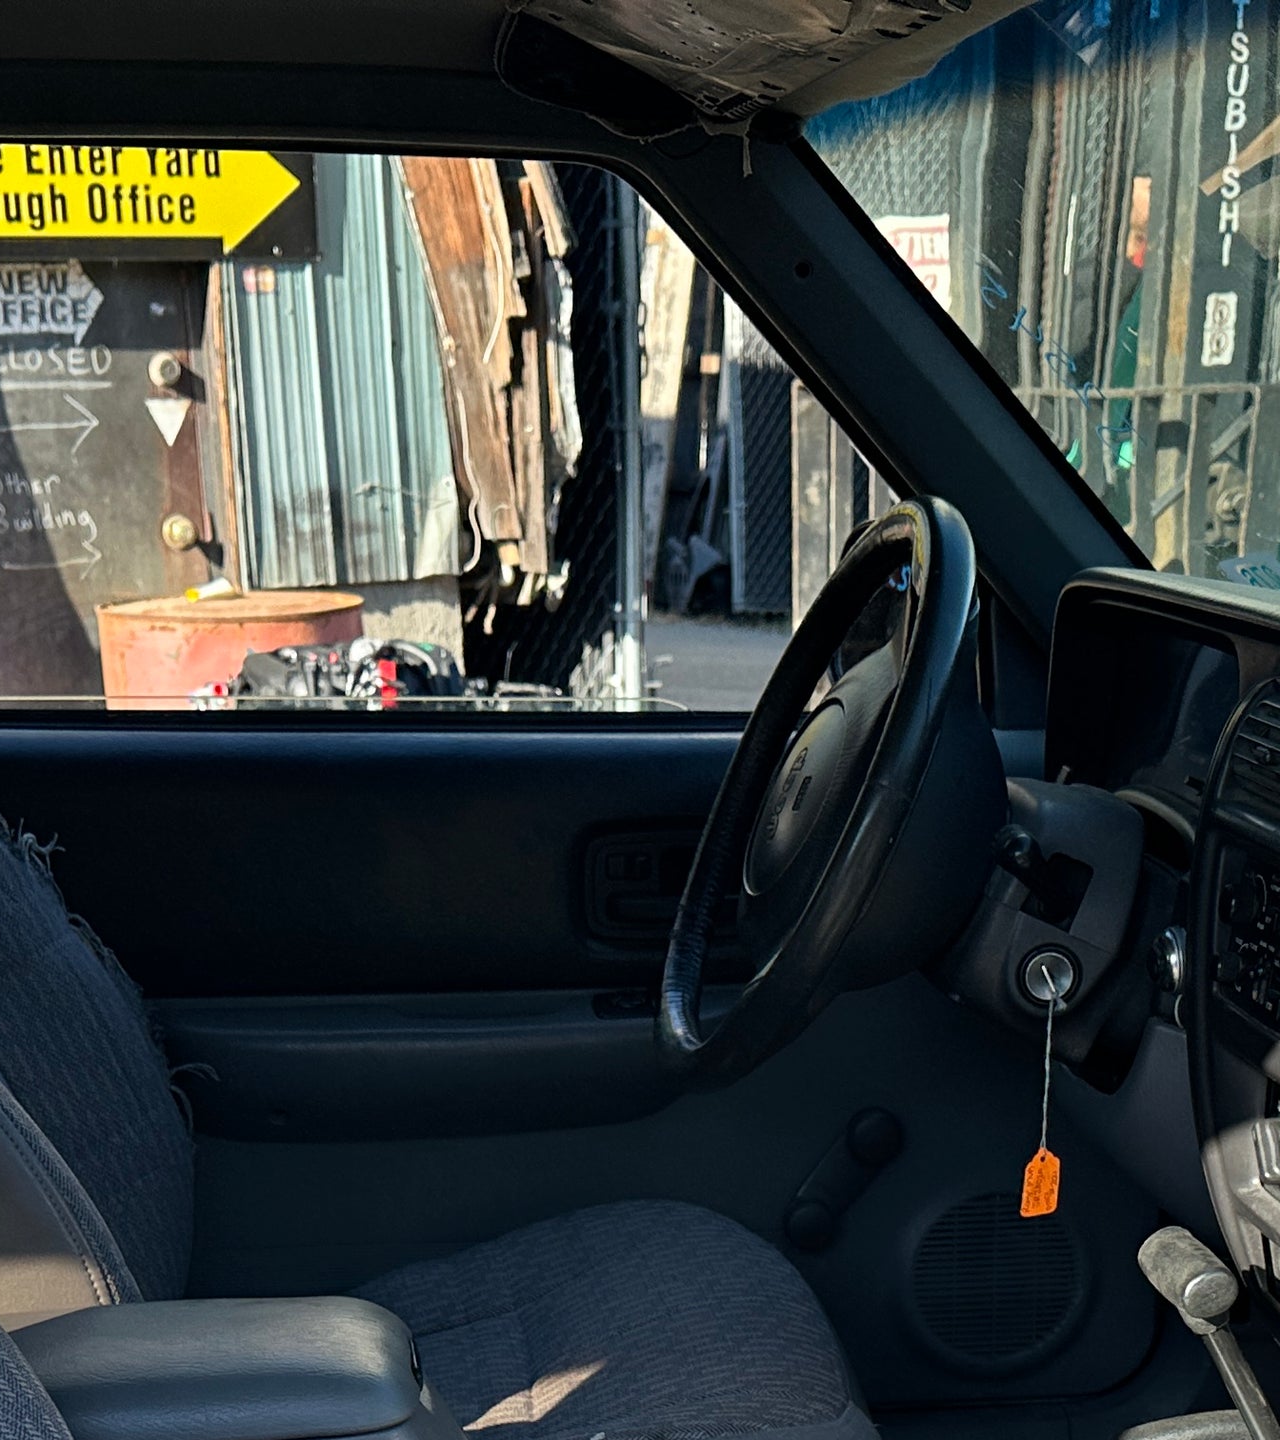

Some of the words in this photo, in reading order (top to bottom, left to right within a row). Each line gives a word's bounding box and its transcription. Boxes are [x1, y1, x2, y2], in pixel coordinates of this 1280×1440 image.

[24, 143, 122, 176] Enter
[145, 147, 221, 178] Yard
[87, 182, 197, 225] Office
